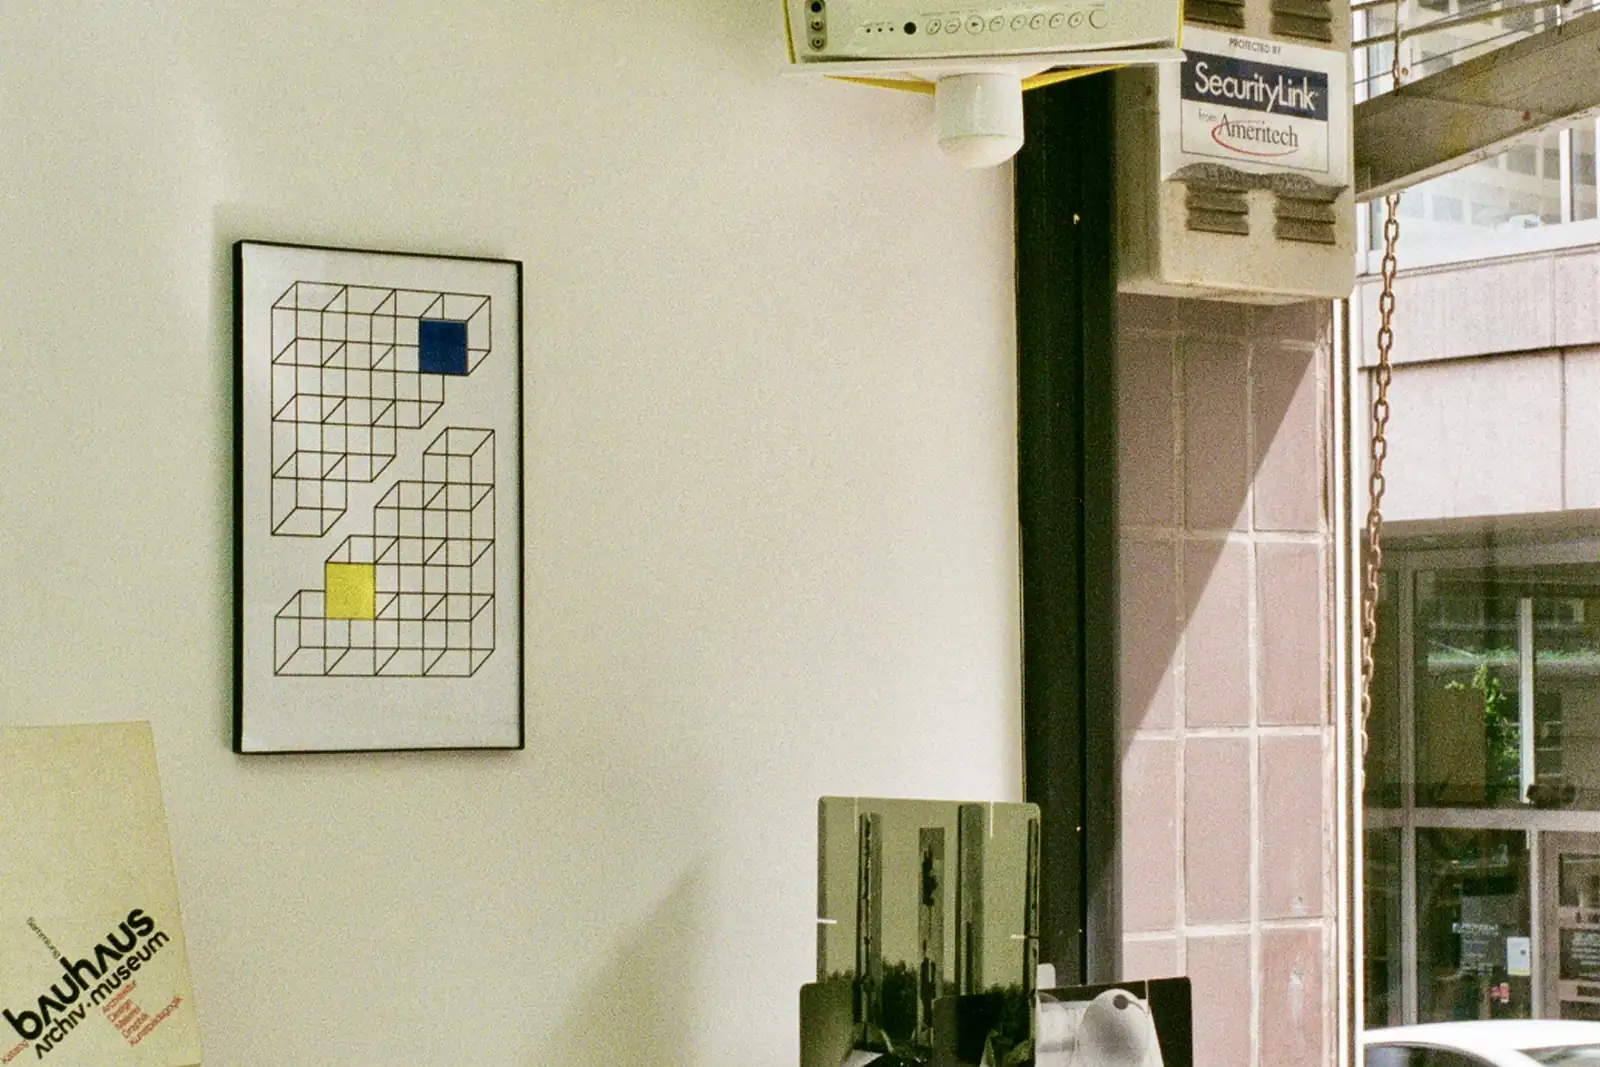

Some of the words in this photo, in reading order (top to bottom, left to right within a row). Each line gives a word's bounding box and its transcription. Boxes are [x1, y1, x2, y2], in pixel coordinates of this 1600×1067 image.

[1228, 37, 1270, 54] PROTECTED
[1194, 61, 1315, 113] SecurityLink
[1217, 113, 1299, 148] Ameritech
